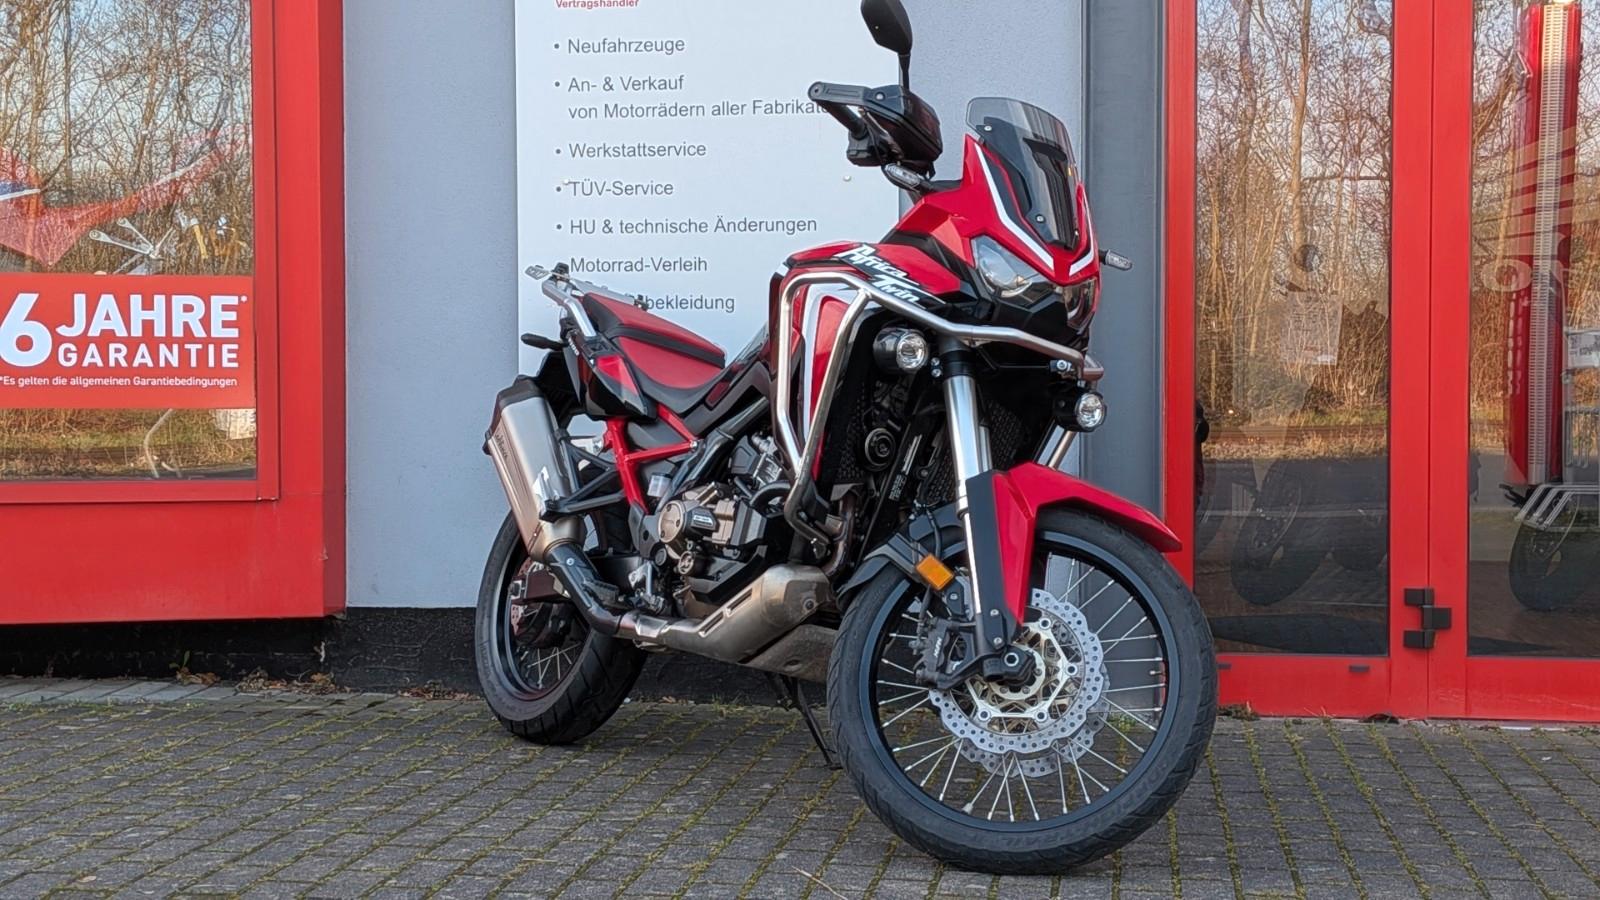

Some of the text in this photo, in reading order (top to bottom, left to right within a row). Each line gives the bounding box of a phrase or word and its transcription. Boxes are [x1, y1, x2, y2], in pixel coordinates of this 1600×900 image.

[568, 37, 685, 56] Neufahrzeuge
[568, 74, 685, 93] An- & Verkauf
[568, 107, 598, 119] von
[604, 101, 706, 119] Motorrädern
[711, 99, 747, 117] aller
[569, 141, 707, 159] Werkstattservice
[569, 177, 674, 197] TÜV-Service
[570, 214, 818, 235] HU & technische Änderungen
[571, 256, 708, 273] Motorrad-Verleih
[833, 243, 908, 278] Africa
[0, 292, 53, 367] 6
[58, 342, 239, 368] GARANTIE
[18, 376, 49, 388] gelten
[52, 376, 67, 386] die
[70, 376, 131, 388] allgemeinen
[133, 376, 237, 389] Garantiebedingungen
